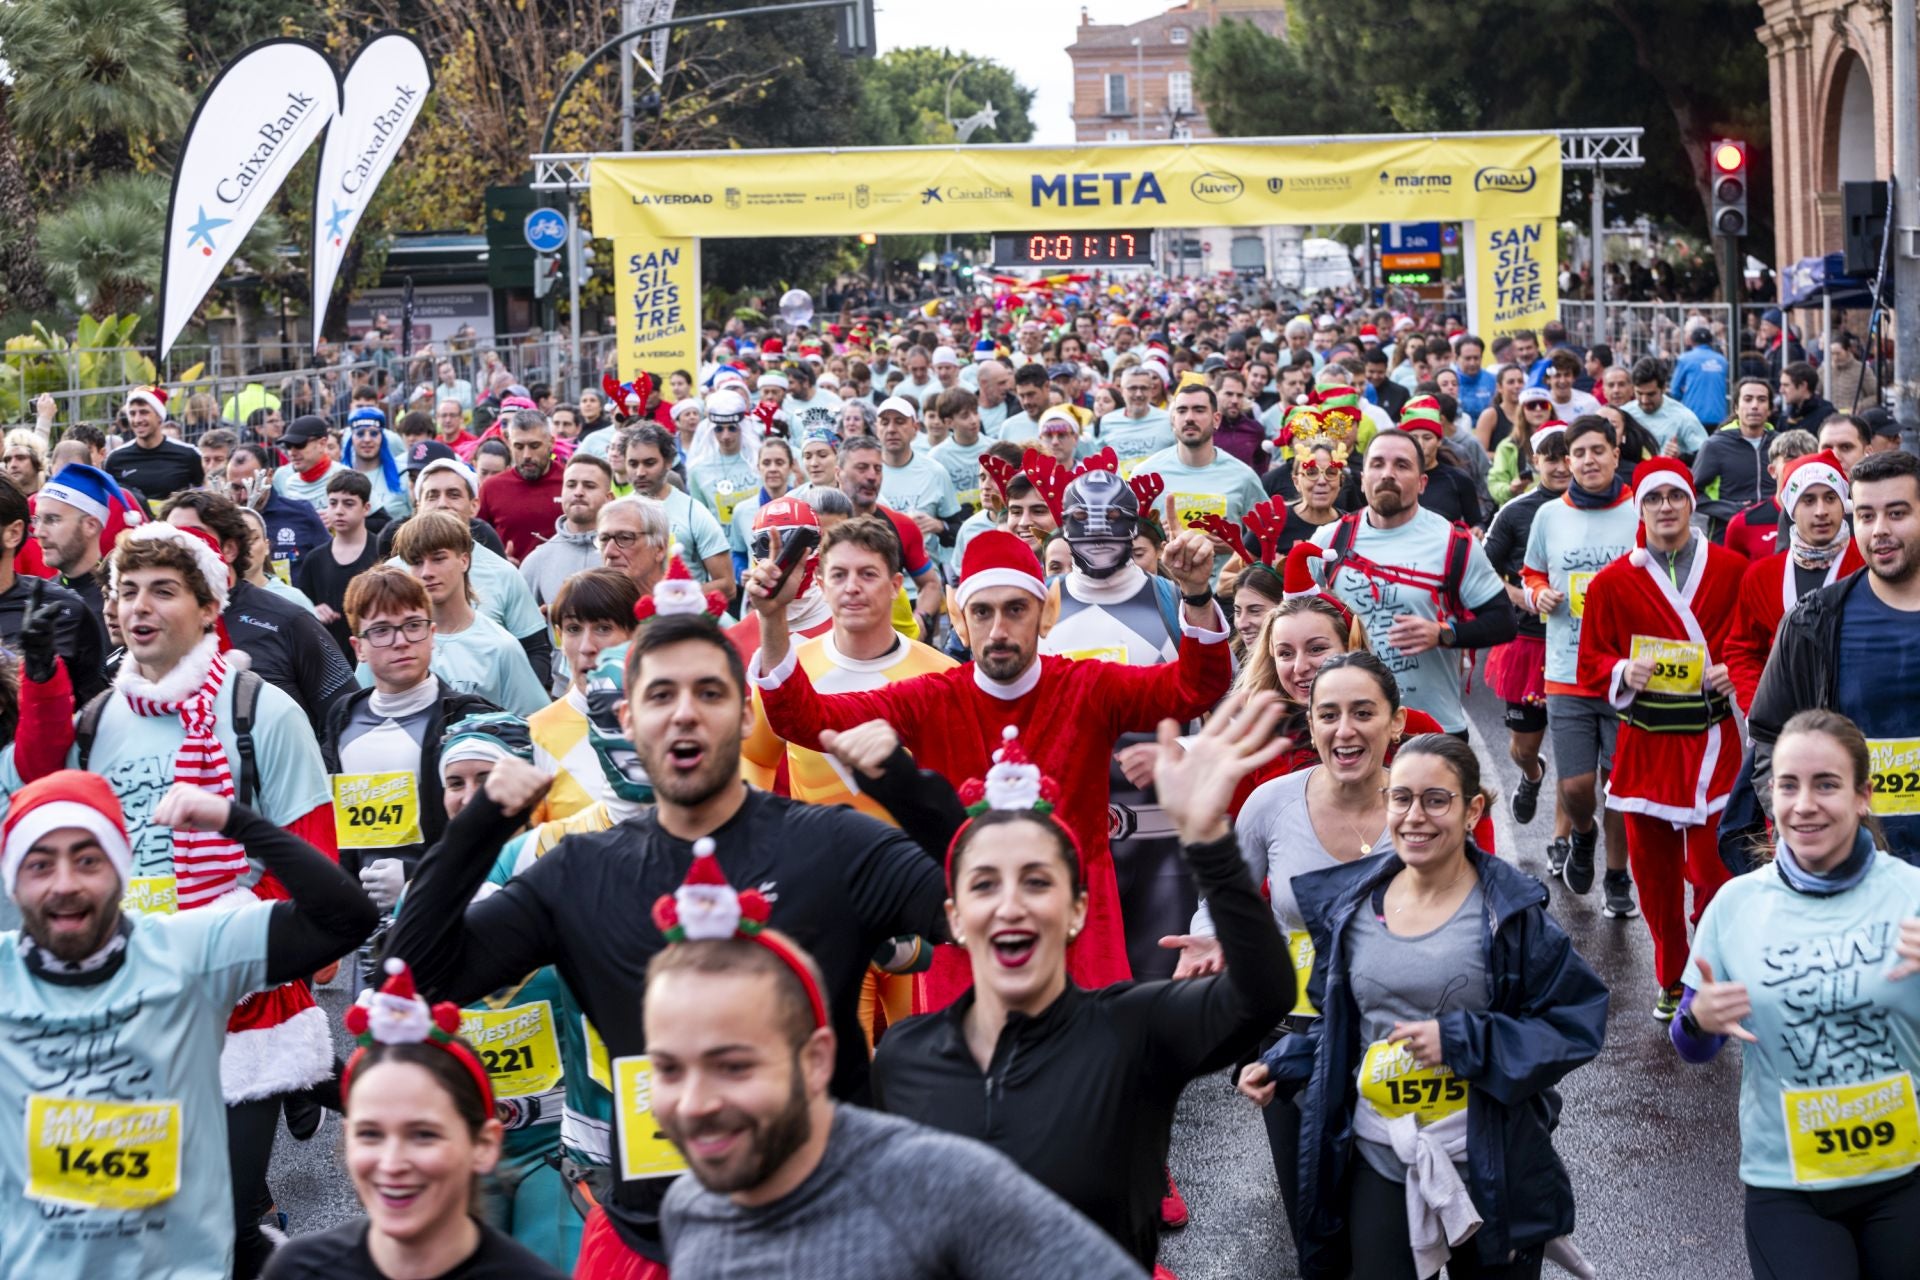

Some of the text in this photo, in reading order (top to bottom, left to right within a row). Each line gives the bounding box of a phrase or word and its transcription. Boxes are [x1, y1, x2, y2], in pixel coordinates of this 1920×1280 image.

[216, 90, 314, 204] CaixaBank
[341, 83, 418, 195] CaixaBank
[1031, 171, 1167, 207] META
[1197, 182, 1238, 194] Juver
[1394, 174, 1452, 187] marmo
[1483, 173, 1528, 186] VIDAL
[632, 193, 713, 206] LA VERDAD
[947, 187, 1014, 200] CaixaBank
[1029, 234, 1136, 262] 0:01:17
[1489, 223, 1542, 251] SAN
[629, 247, 680, 274] SAN
[1498, 246, 1534, 269] SIL
[638, 268, 673, 292] SIL
[1494, 262, 1540, 288] VES
[634, 286, 679, 311] VES
[1495, 283, 1541, 308] TRE
[634, 306, 681, 331] TRE
[1494, 301, 1546, 322] MURCIA
[648, 350, 685, 358] VERDAD
[341, 777, 369, 797] SAN
[1871, 772, 1920, 794] 292
[347, 804, 404, 827] 2047
[1761, 921, 1891, 987] SAN
[1782, 969, 1875, 1028] SIL
[478, 1045, 534, 1074] 221
[1386, 1078, 1466, 1105] 1575
[1797, 1093, 1838, 1117] SAN
[1797, 1080, 1905, 1134] SILVESTRE
[41, 1108, 171, 1148] SILVESTRE
[43, 1105, 96, 1132] SAN
[1813, 1120, 1896, 1155] 3109
[55, 1146, 150, 1179] 1463
